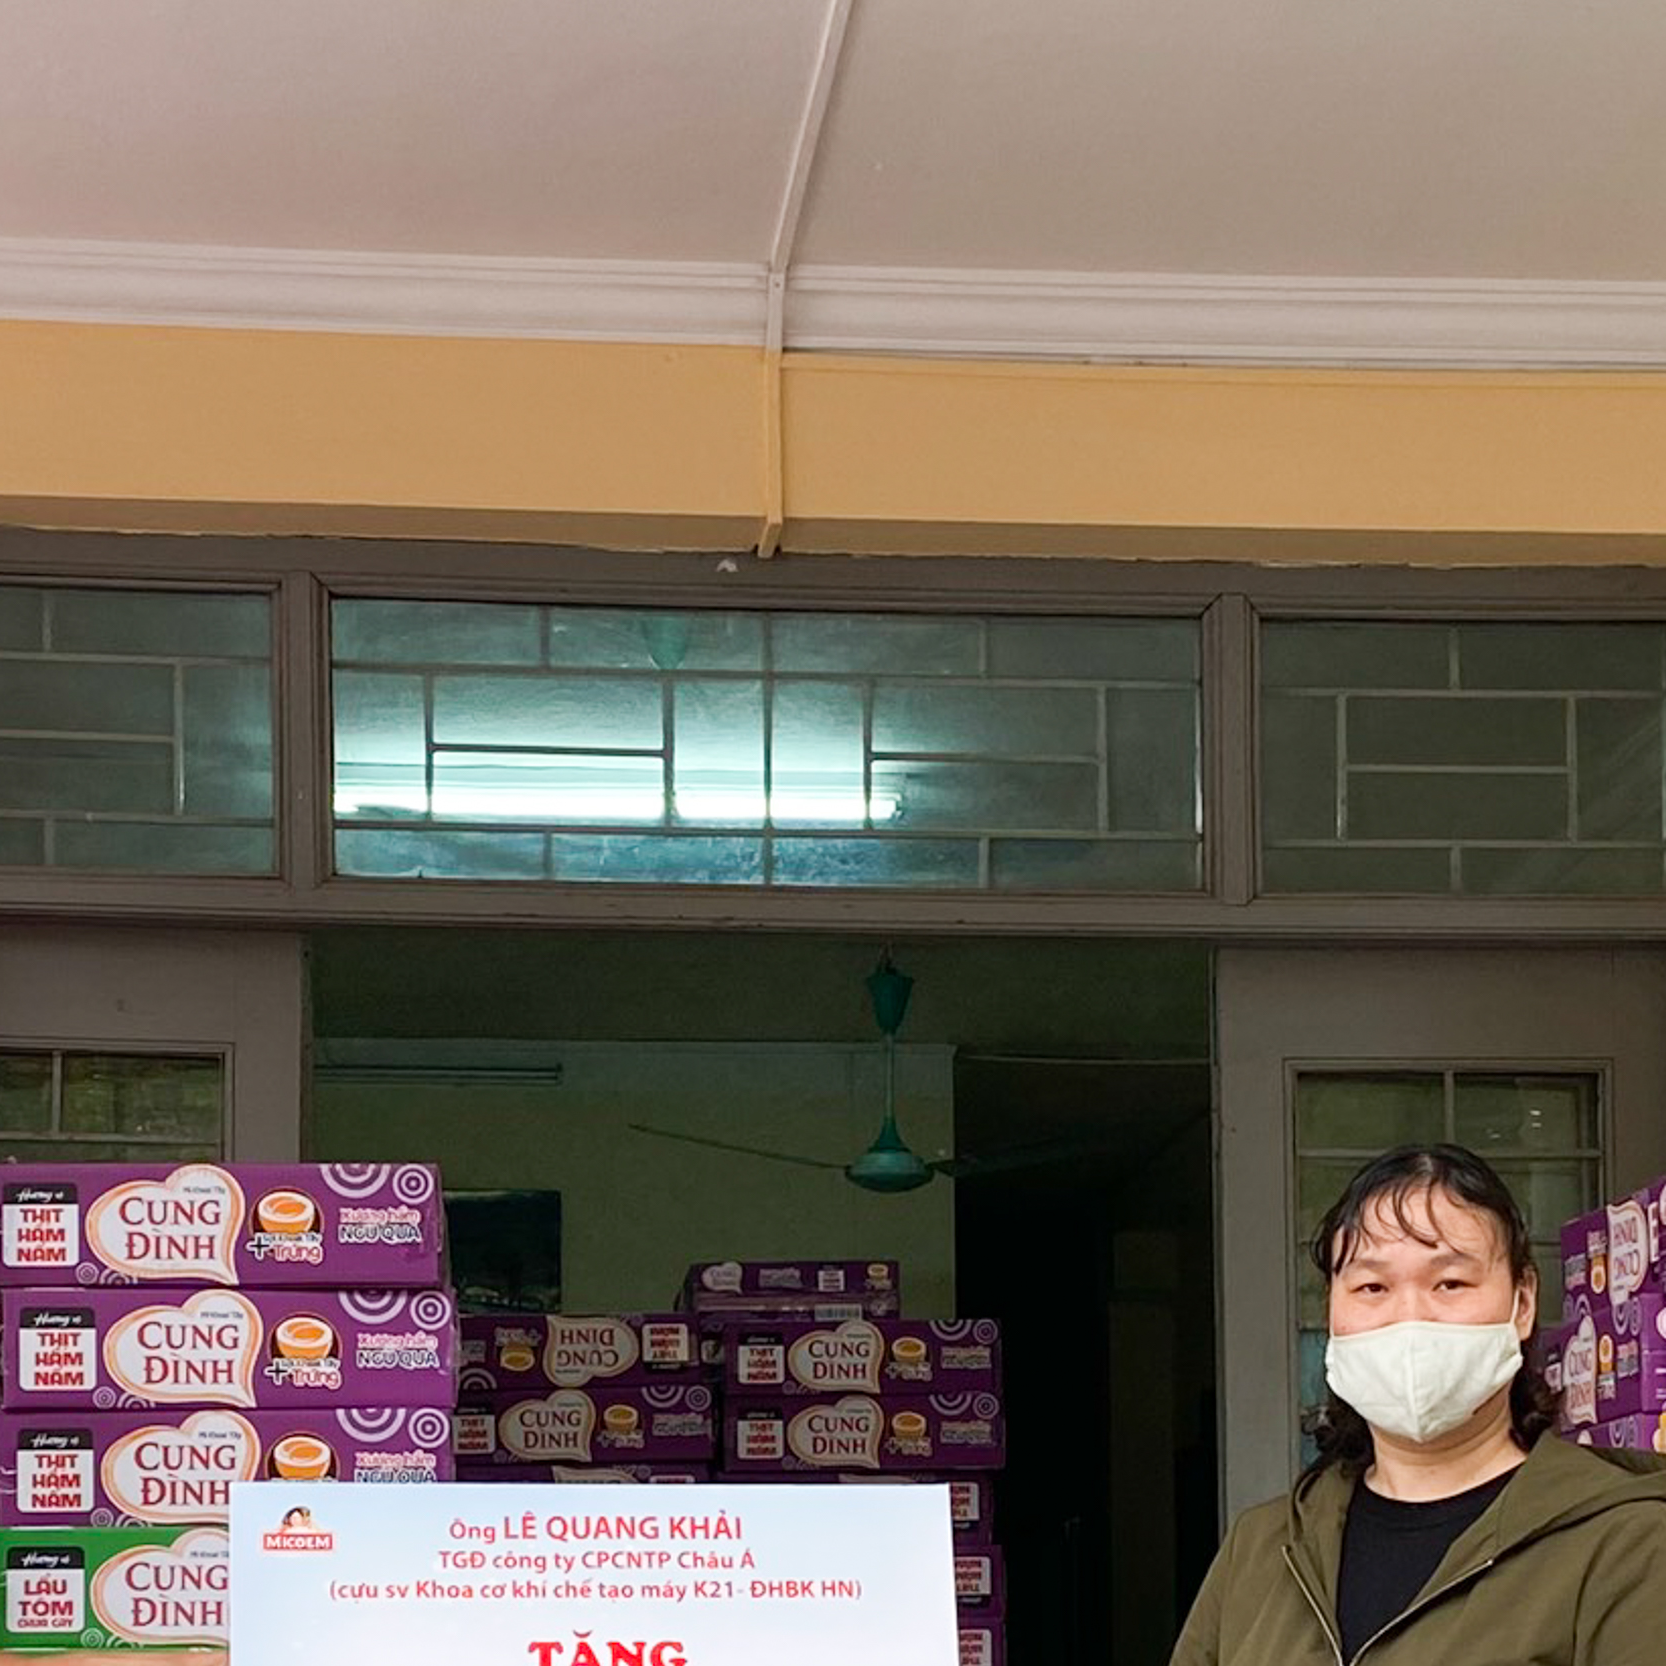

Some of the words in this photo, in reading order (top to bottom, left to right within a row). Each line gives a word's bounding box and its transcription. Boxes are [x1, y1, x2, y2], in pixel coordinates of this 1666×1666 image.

[120, 1197, 221, 1226] CUNG
[125, 1226, 217, 1260] ĐÌNH
[809, 1342, 871, 1359] CUNG
[449, 1518, 495, 1544] Ông
[504, 1511, 537, 1539] LÊ
[546, 1515, 660, 1540] QUANG
[669, 1509, 742, 1539] KHẢI
[439, 1551, 484, 1569] TGĐ
[493, 1550, 547, 1573] công
[554, 1553, 574, 1574] ty
[582, 1551, 671, 1569] CPCNTP
[678, 1550, 734, 1569] Châu
[740, 1548, 755, 1569] Á
[329, 1580, 378, 1604] (cựu
[386, 1586, 409, 1600] sv
[416, 1580, 473, 1600] Khoa
[480, 1584, 508, 1600] cơ
[512, 1579, 547, 1600] khí
[553, 1577, 592, 1600] chế
[599, 1582, 634, 1603] tạo
[641, 1581, 688, 1603] máy
[750, 1580, 815, 1599] ĐHBK
[821, 1580, 862, 1601] HN)
